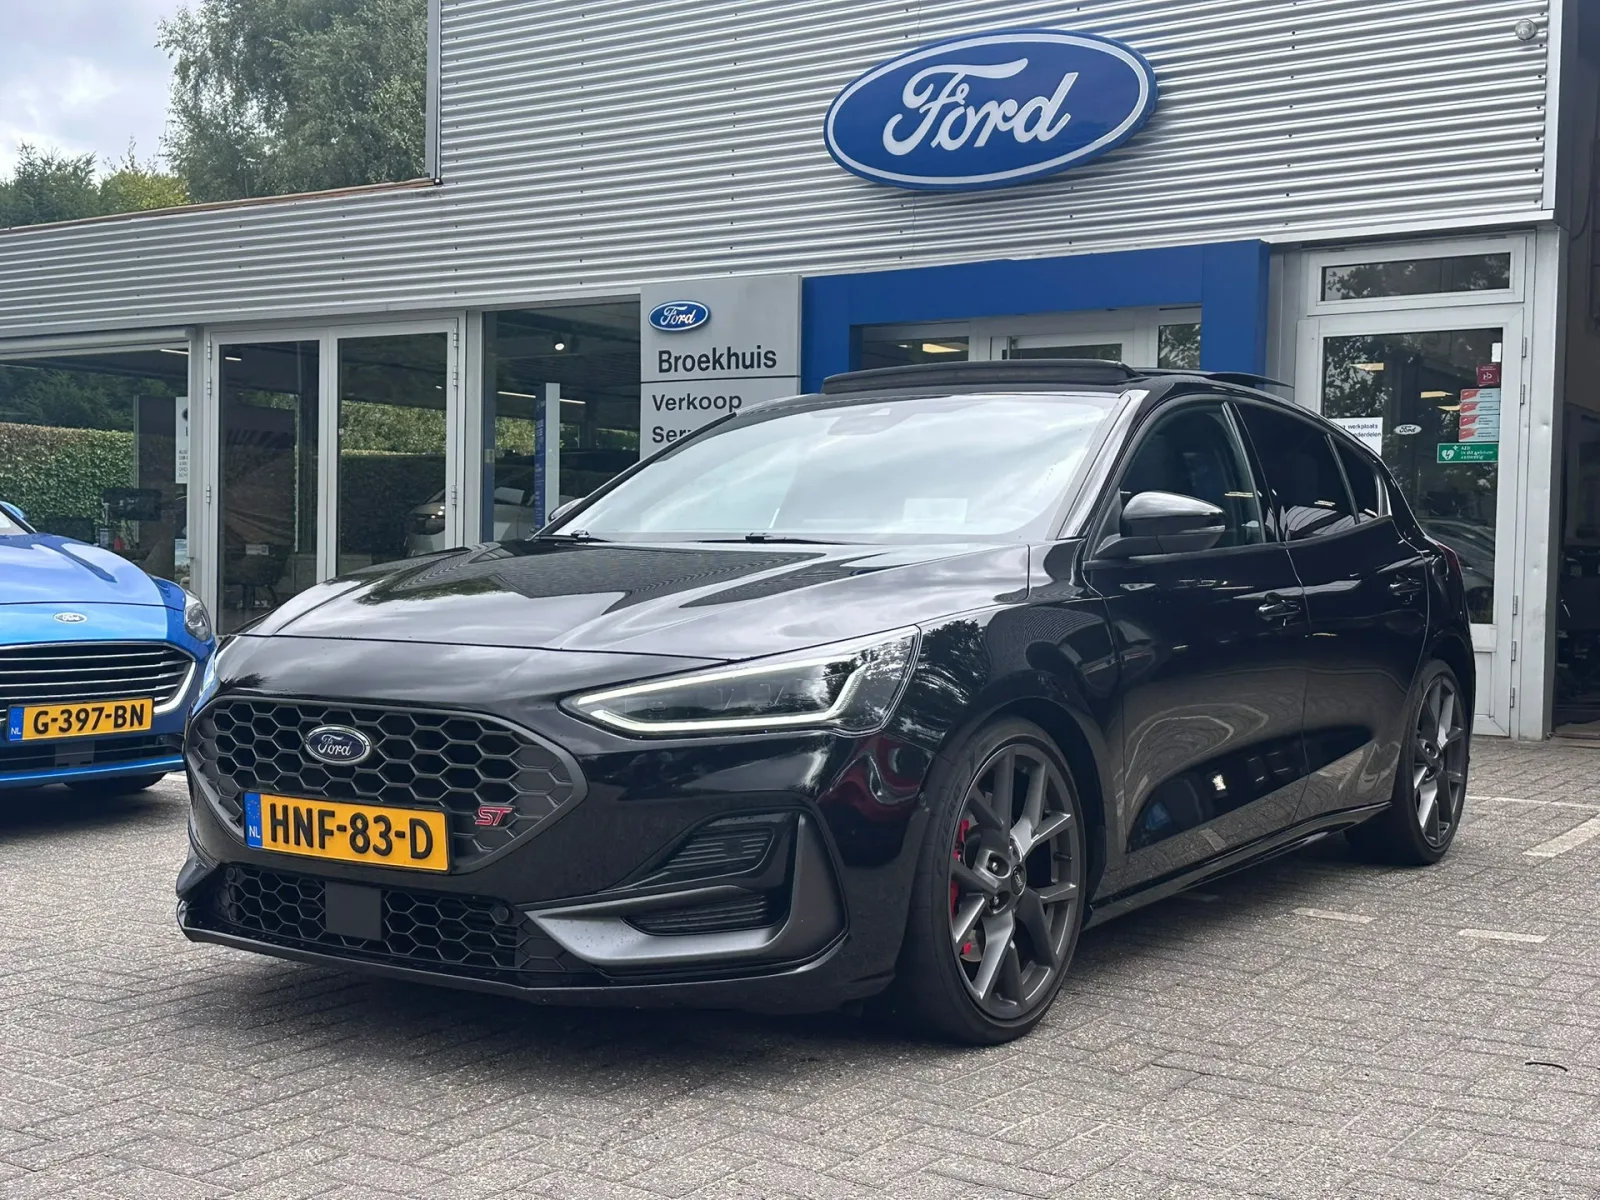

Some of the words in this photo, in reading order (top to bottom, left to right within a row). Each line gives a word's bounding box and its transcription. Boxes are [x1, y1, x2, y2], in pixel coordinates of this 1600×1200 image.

[882, 57, 1079, 156] Ford
[660, 306, 696, 325] Ford
[657, 344, 778, 374] Broekhuis
[651, 392, 743, 413] Verkoop
[11, 727, 21, 735] NL
[33, 703, 145, 735] G-397-BN
[317, 734, 352, 757] Ford
[475, 804, 513, 826] ST
[248, 825, 261, 839] NL
[268, 802, 434, 860] HNF-83-D
